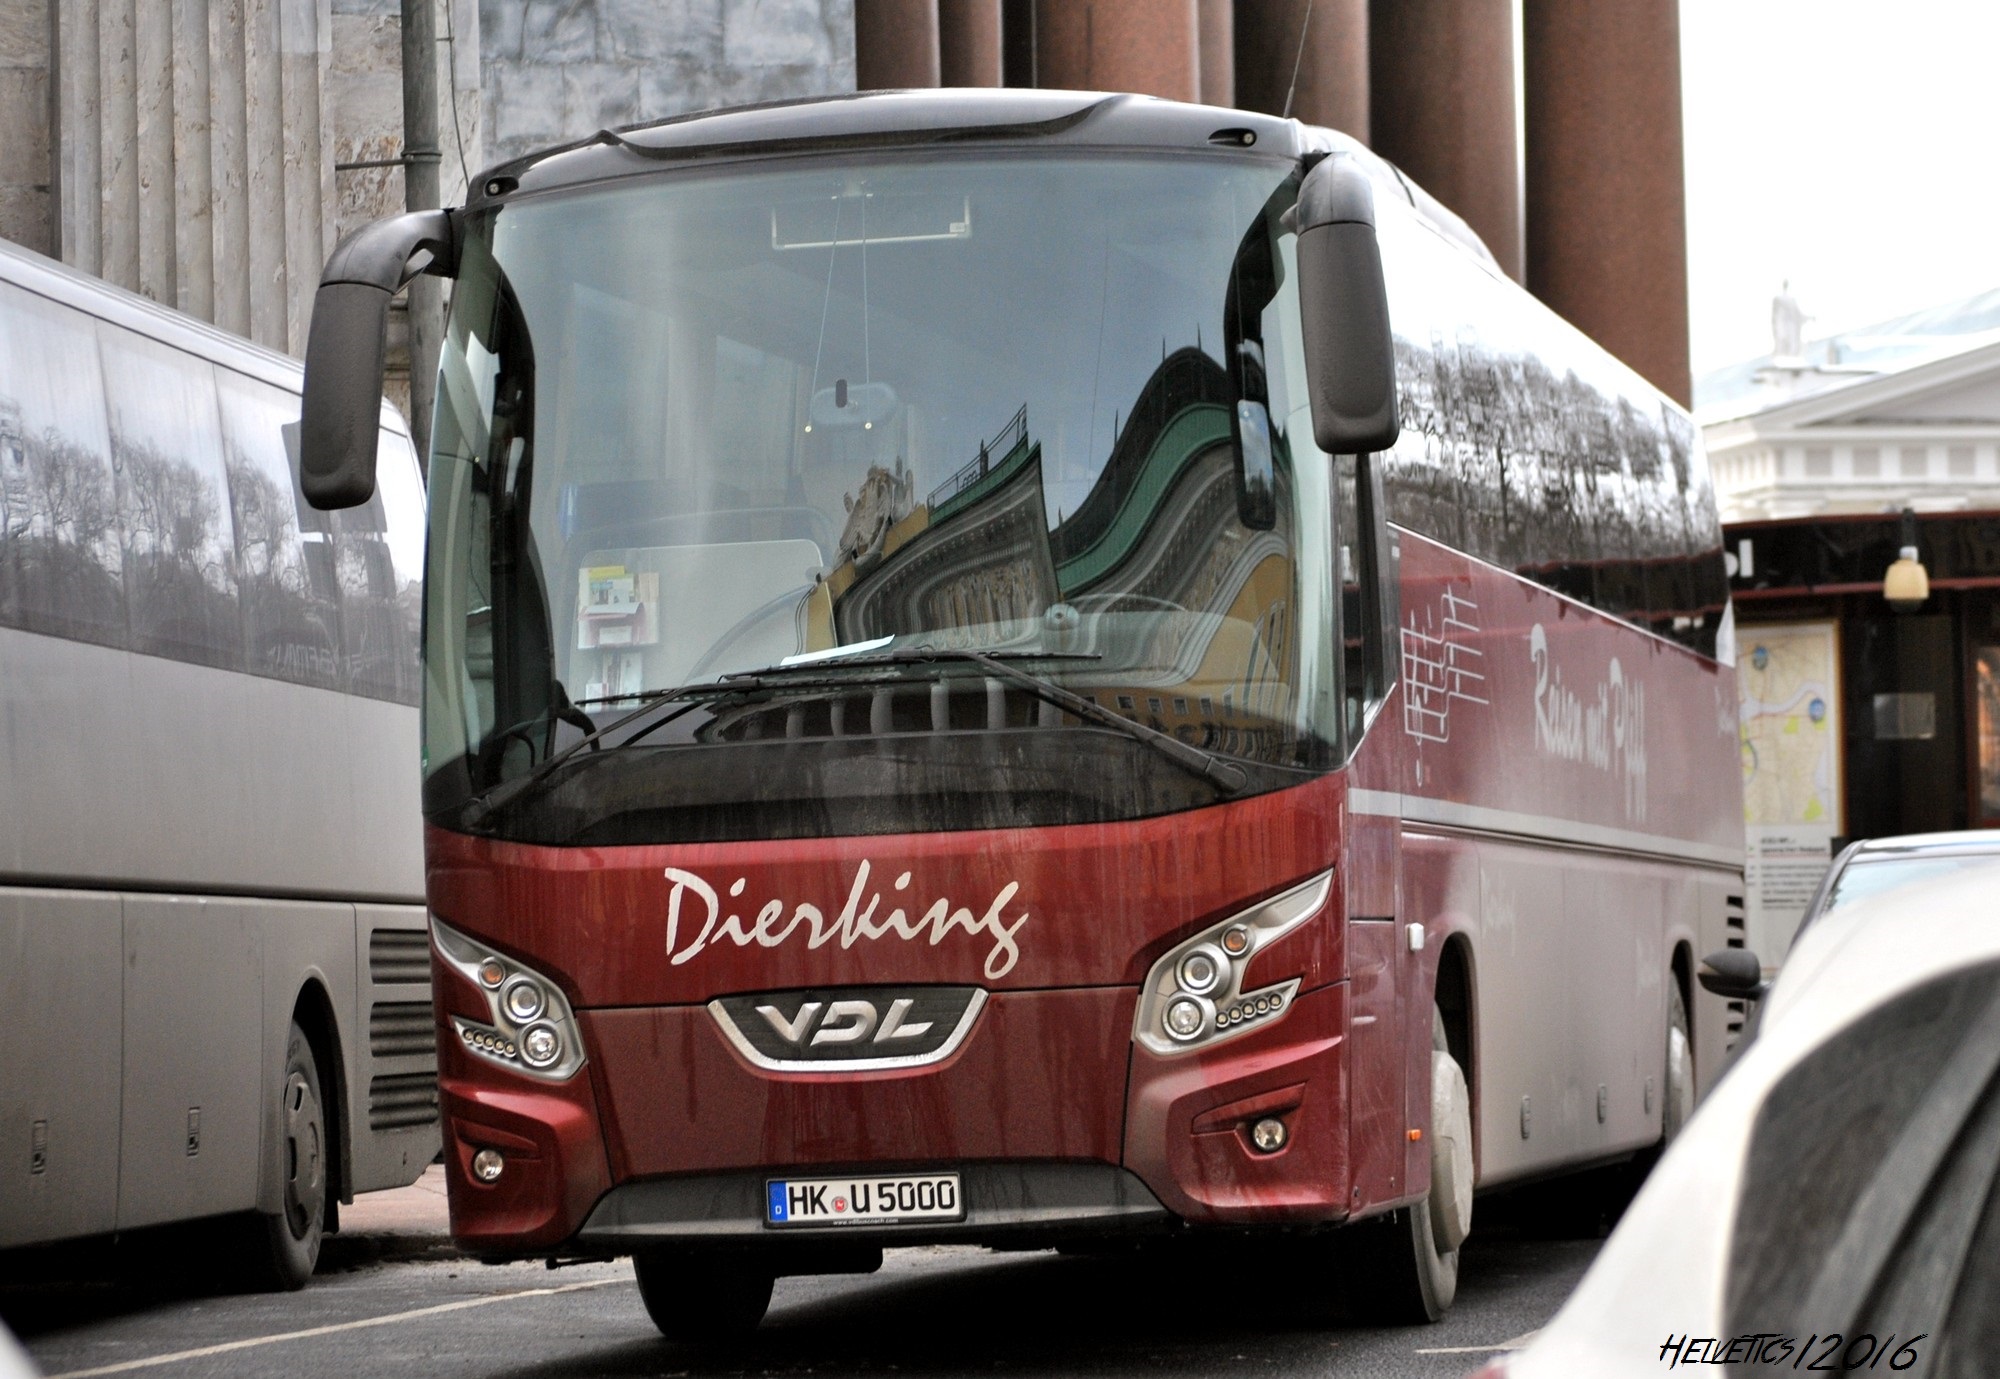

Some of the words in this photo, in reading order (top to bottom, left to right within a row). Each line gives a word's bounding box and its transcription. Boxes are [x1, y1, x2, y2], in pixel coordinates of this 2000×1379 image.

[664, 858, 1029, 980] Dierking
[755, 998, 934, 1047] VDL
[788, 1185, 829, 1215] HK
